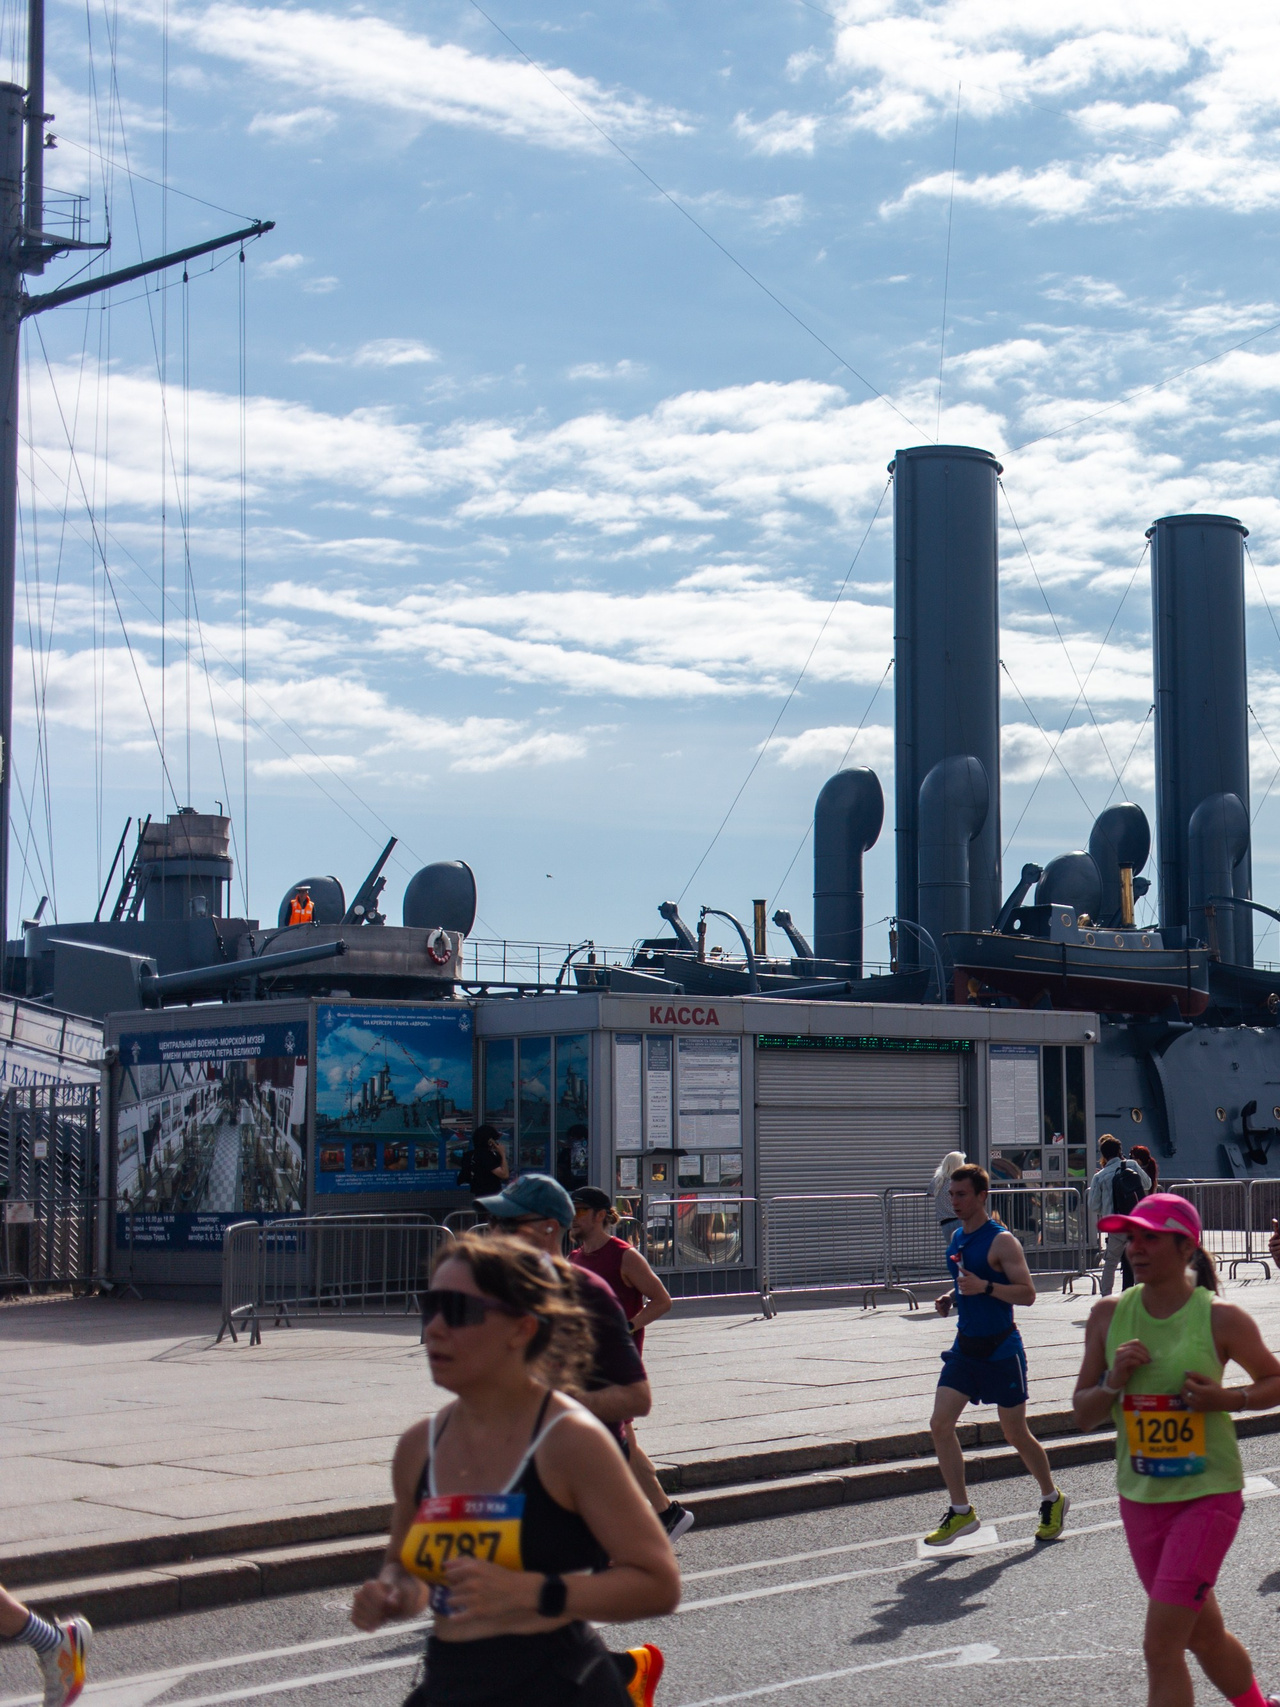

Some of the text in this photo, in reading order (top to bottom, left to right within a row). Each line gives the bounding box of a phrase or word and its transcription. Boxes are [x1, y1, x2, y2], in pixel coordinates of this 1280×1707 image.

[650, 1006, 720, 1026] КАССА
[158, 1033, 265, 1051] ЦЕНТРАЛЬНЫЙ ВОЕННО-МОРСКОЙ МУЗЕЙ
[163, 1046, 261, 1060] ИМЕНИ ИМПЕРАТОРА ПЕТРА ВЕЛИКОГО
[1136, 1417, 1195, 1444] 1206
